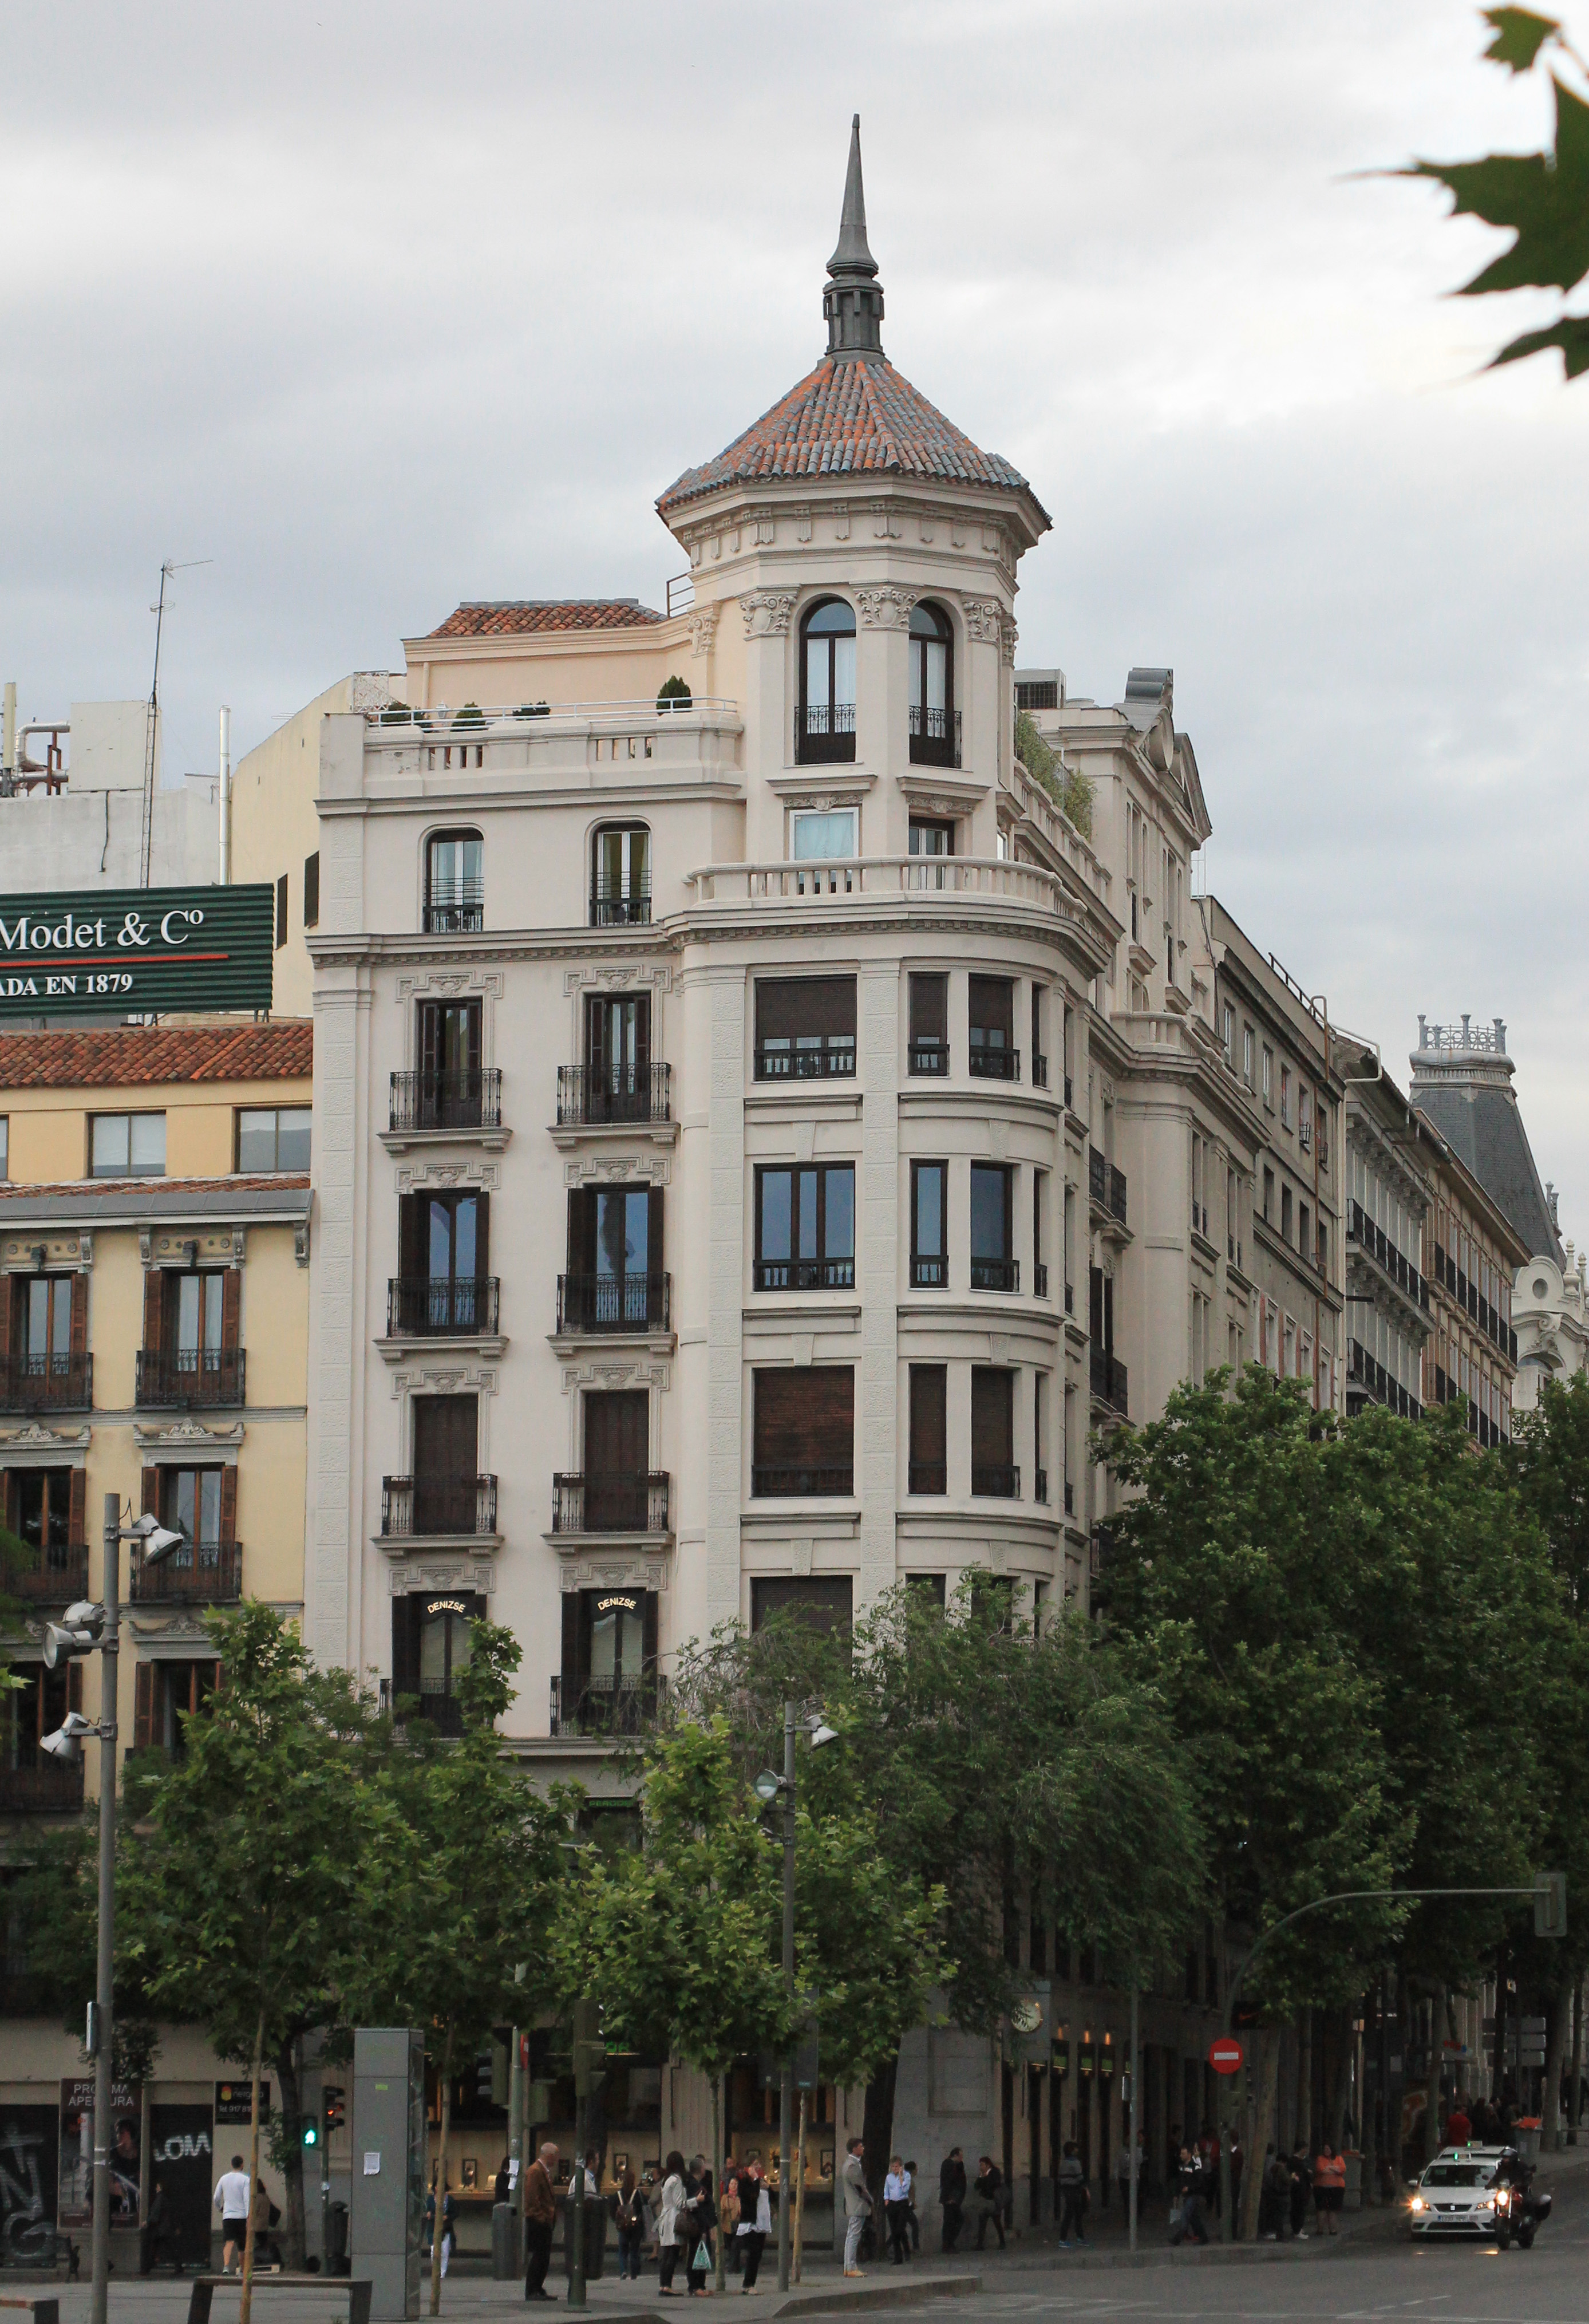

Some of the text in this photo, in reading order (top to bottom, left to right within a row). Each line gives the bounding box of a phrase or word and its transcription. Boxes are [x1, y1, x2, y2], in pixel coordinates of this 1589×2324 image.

[0, 914, 107, 950] Modet
[117, 912, 150, 946] &
[45, 975, 77, 995] EN
[85, 973, 133, 993] 1879
[426, 1600, 466, 1614] DENIZSE
[598, 1597, 637, 1611] DENIZSE
